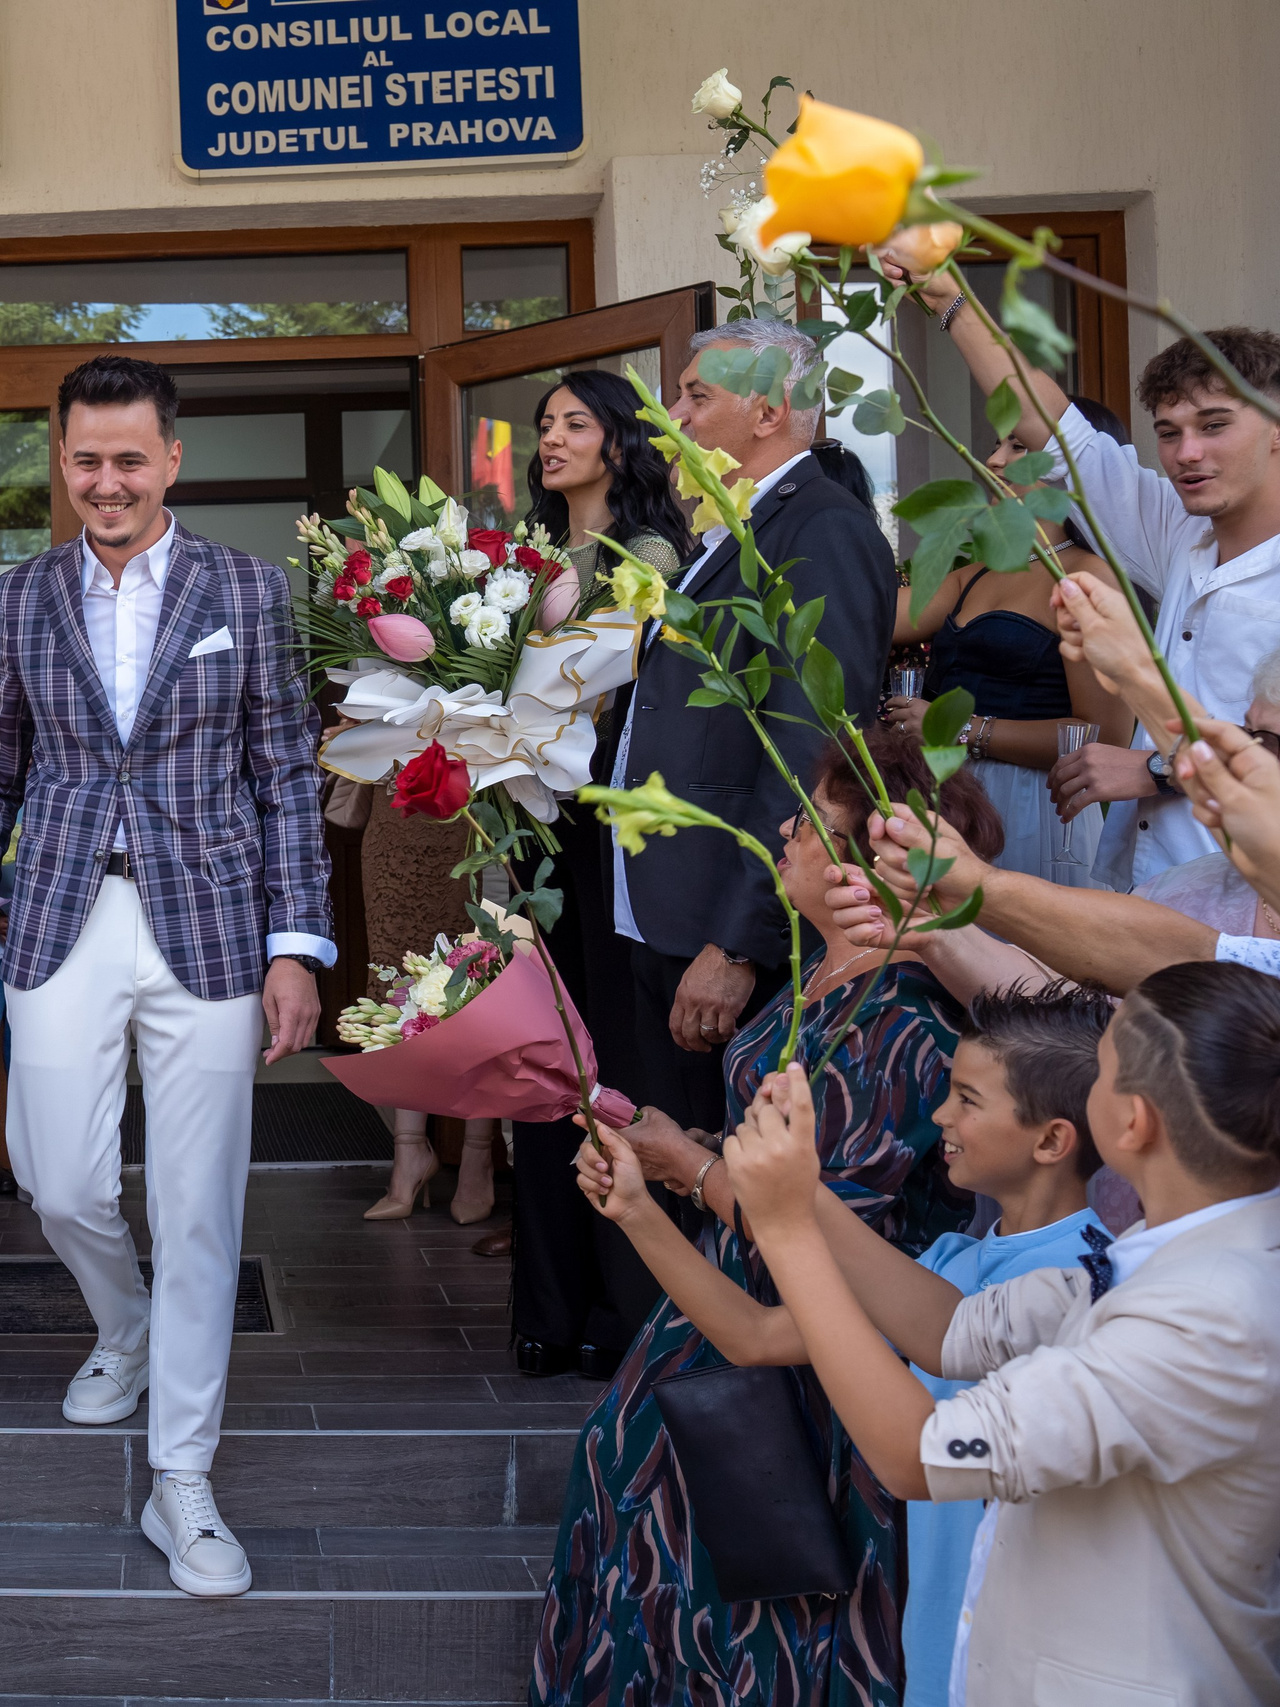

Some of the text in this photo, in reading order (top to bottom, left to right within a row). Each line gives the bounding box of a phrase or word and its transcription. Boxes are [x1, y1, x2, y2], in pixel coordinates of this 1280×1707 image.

[206, 8, 550, 51] CONSILIUL LOCAL
[363, 51, 393, 67] AL
[207, 66, 554, 115] COMUNEI STEFESTI
[208, 117, 556, 156] JUDETUL PRAHOVA
